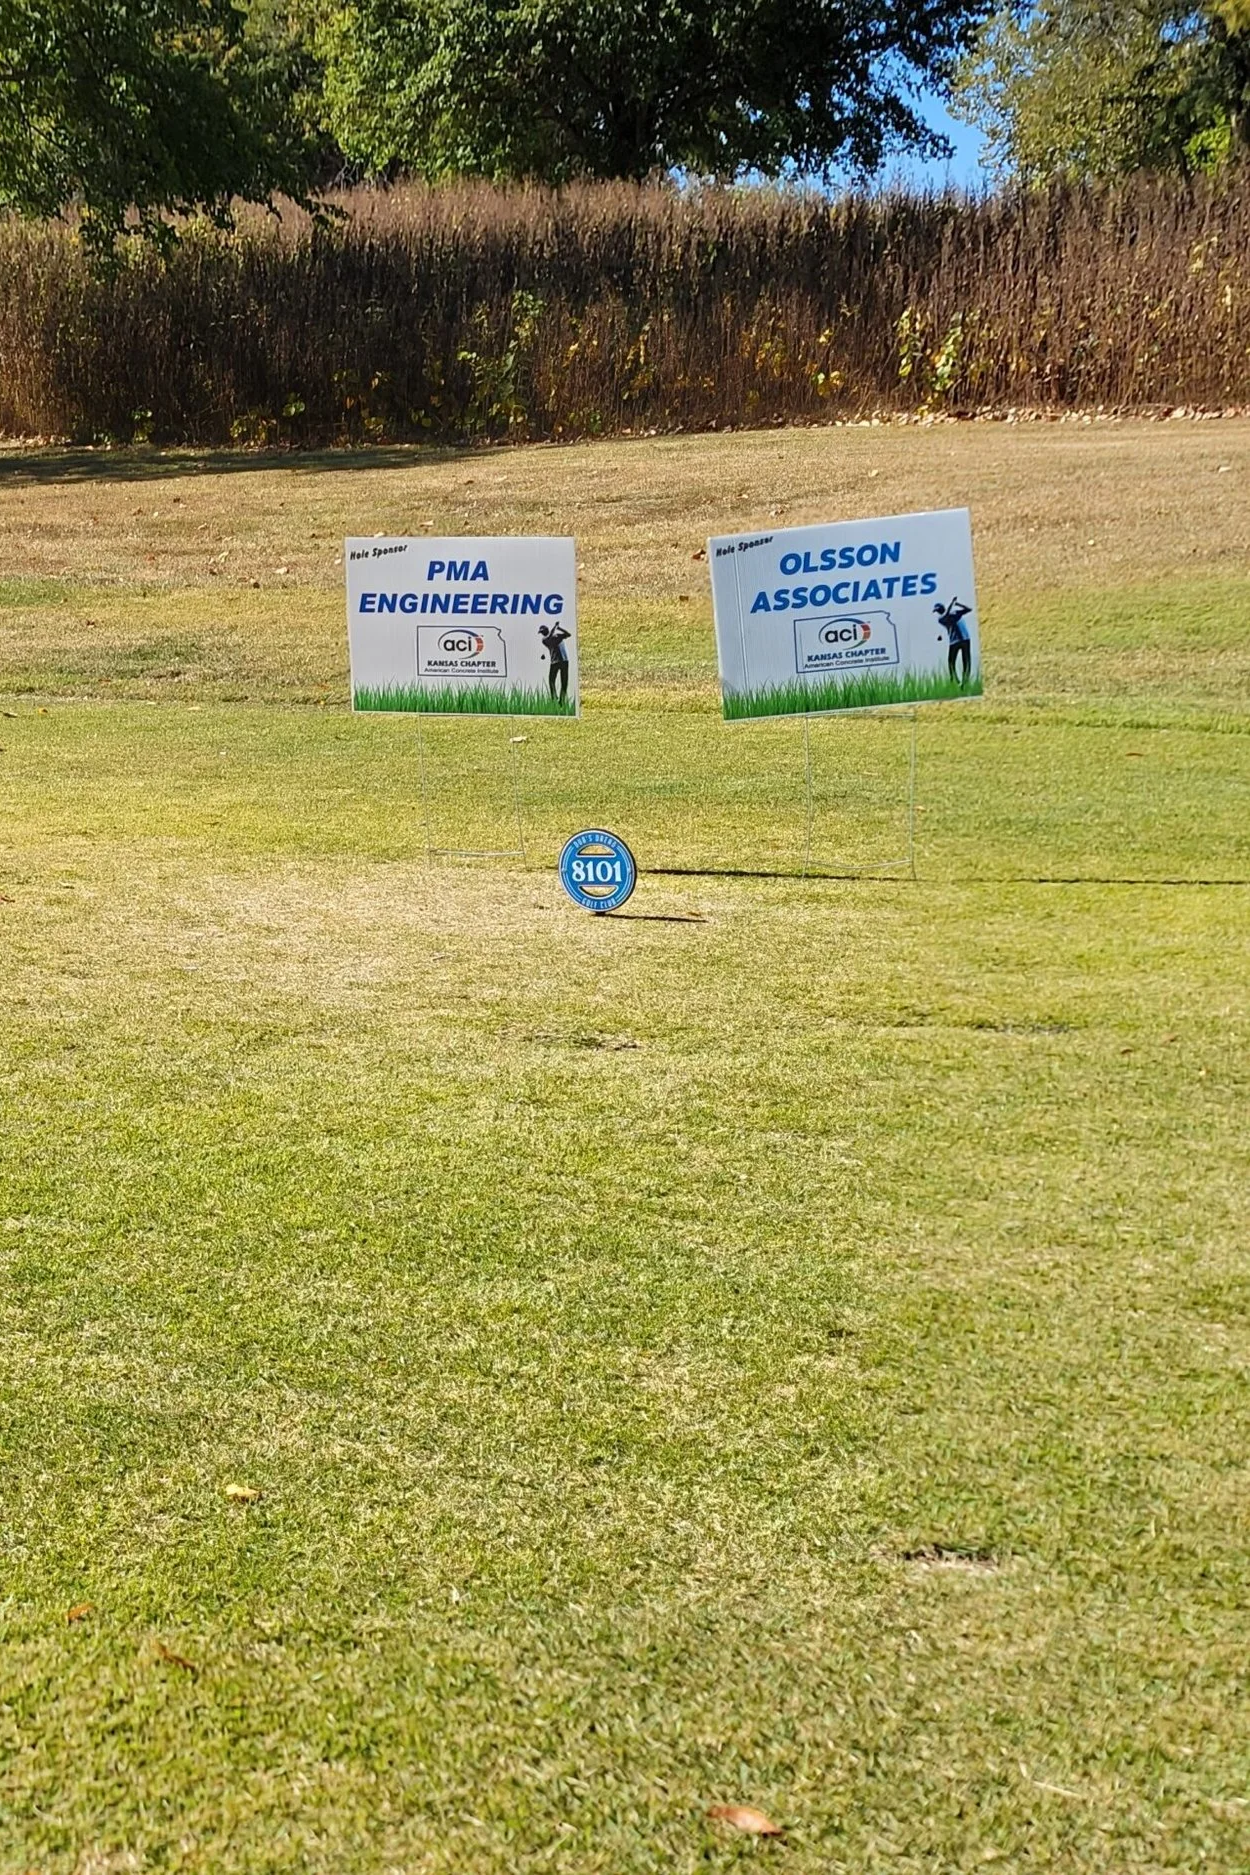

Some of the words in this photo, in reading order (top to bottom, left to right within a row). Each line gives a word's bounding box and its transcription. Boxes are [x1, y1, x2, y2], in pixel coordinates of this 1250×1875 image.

[349, 549, 370, 561] Hole
[371, 544, 408, 559] Sponsor
[715, 544, 736, 558] Hole
[738, 535, 774, 553] Sponsor
[779, 541, 901, 576] OLSSON
[426, 560, 490, 582] PMA
[750, 572, 938, 614] ASSOCIATES
[358, 593, 565, 615] ENGINEERING
[824, 623, 859, 643] aci
[443, 636, 472, 652] aci
[460, 660, 497, 668] CHAPTER
[804, 660, 834, 669] American
[835, 658, 864, 666] Concrete
[807, 652, 843, 663] KANSAS
[845, 647, 887, 658] CHAPTER
[571, 860, 623, 882] 8101
